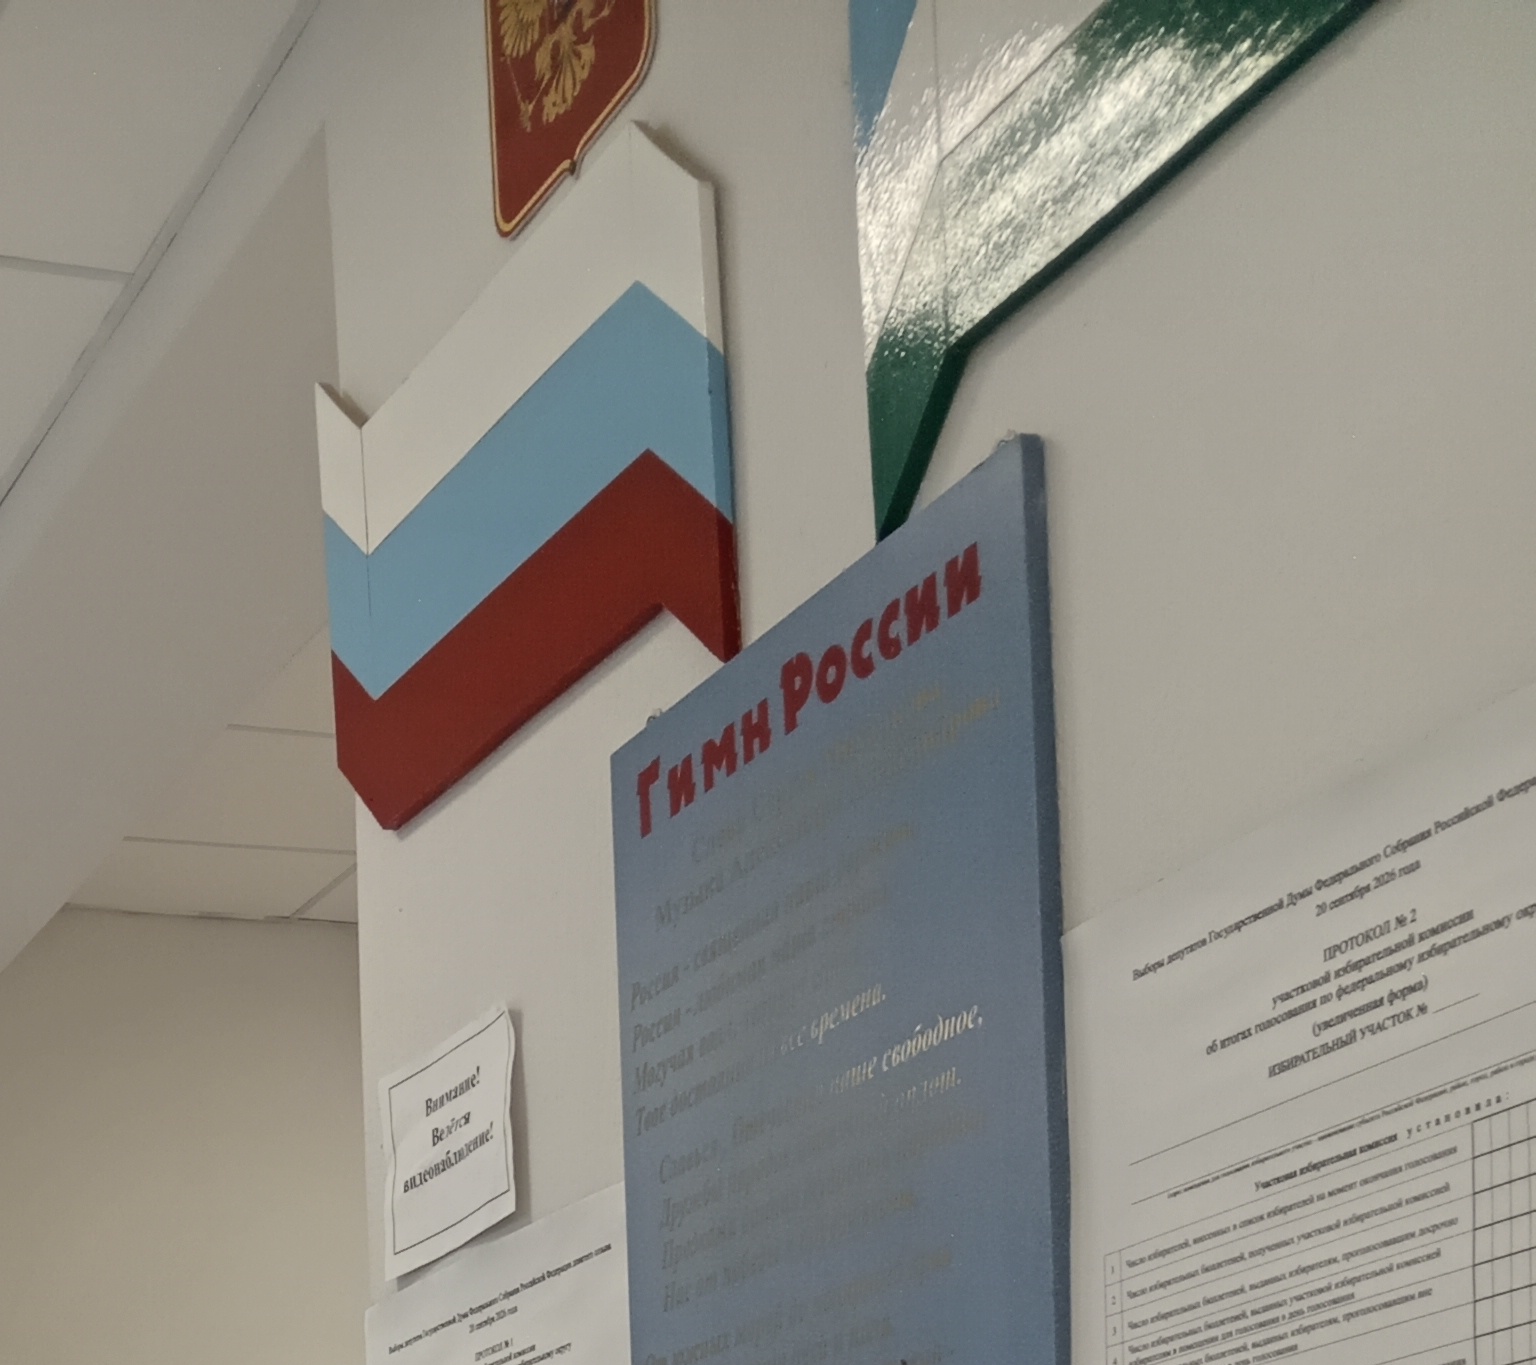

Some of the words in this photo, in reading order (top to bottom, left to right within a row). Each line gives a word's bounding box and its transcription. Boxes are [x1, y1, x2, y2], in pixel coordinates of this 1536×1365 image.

[636, 697, 772, 839] Гимн
[779, 541, 983, 736] России
[1132, 957, 1165, 981] Выборы
[1208, 897, 1284, 943] Государственной
[1286, 885, 1313, 908] Думы
[1314, 852, 1382, 891] Федерального
[1382, 827, 1432, 859] Собрания
[1433, 794, 1493, 834] Российской
[1315, 900, 1327, 917] 20
[1328, 882, 1371, 911] сентября
[1397, 859, 1421, 878] года
[1272, 969, 1330, 1010] участковой
[1333, 932, 1415, 980] избирательной
[1418, 908, 1474, 943] комиссии
[1322, 919, 1390, 963] ПРОТОКОЛ
[1393, 913, 1408, 930] №
[1409, 907, 1417, 924] 2
[810, 985, 886, 1044] времена.
[1205, 1038, 1217, 1055] об
[1219, 1026, 1252, 1050] итогах
[1255, 998, 1317, 1034] голосования
[1319, 991, 1333, 1006] по
[1335, 956, 1414, 1001] федеральному
[1417, 912, 1513, 964] избирательному
[1311, 995, 1384, 1037] (увеличенная
[1386, 974, 1429, 1006] форма)
[880, 1004, 983, 1071] свободное,
[1267, 1027, 1356, 1078] ИЗБИРАТЕЛЬНЫЙ
[1359, 1006, 1414, 1040] УЧАСТОК
[425, 1065, 480, 1117] Внимание!
[403, 1121, 494, 1193] видеонаблюдение!
